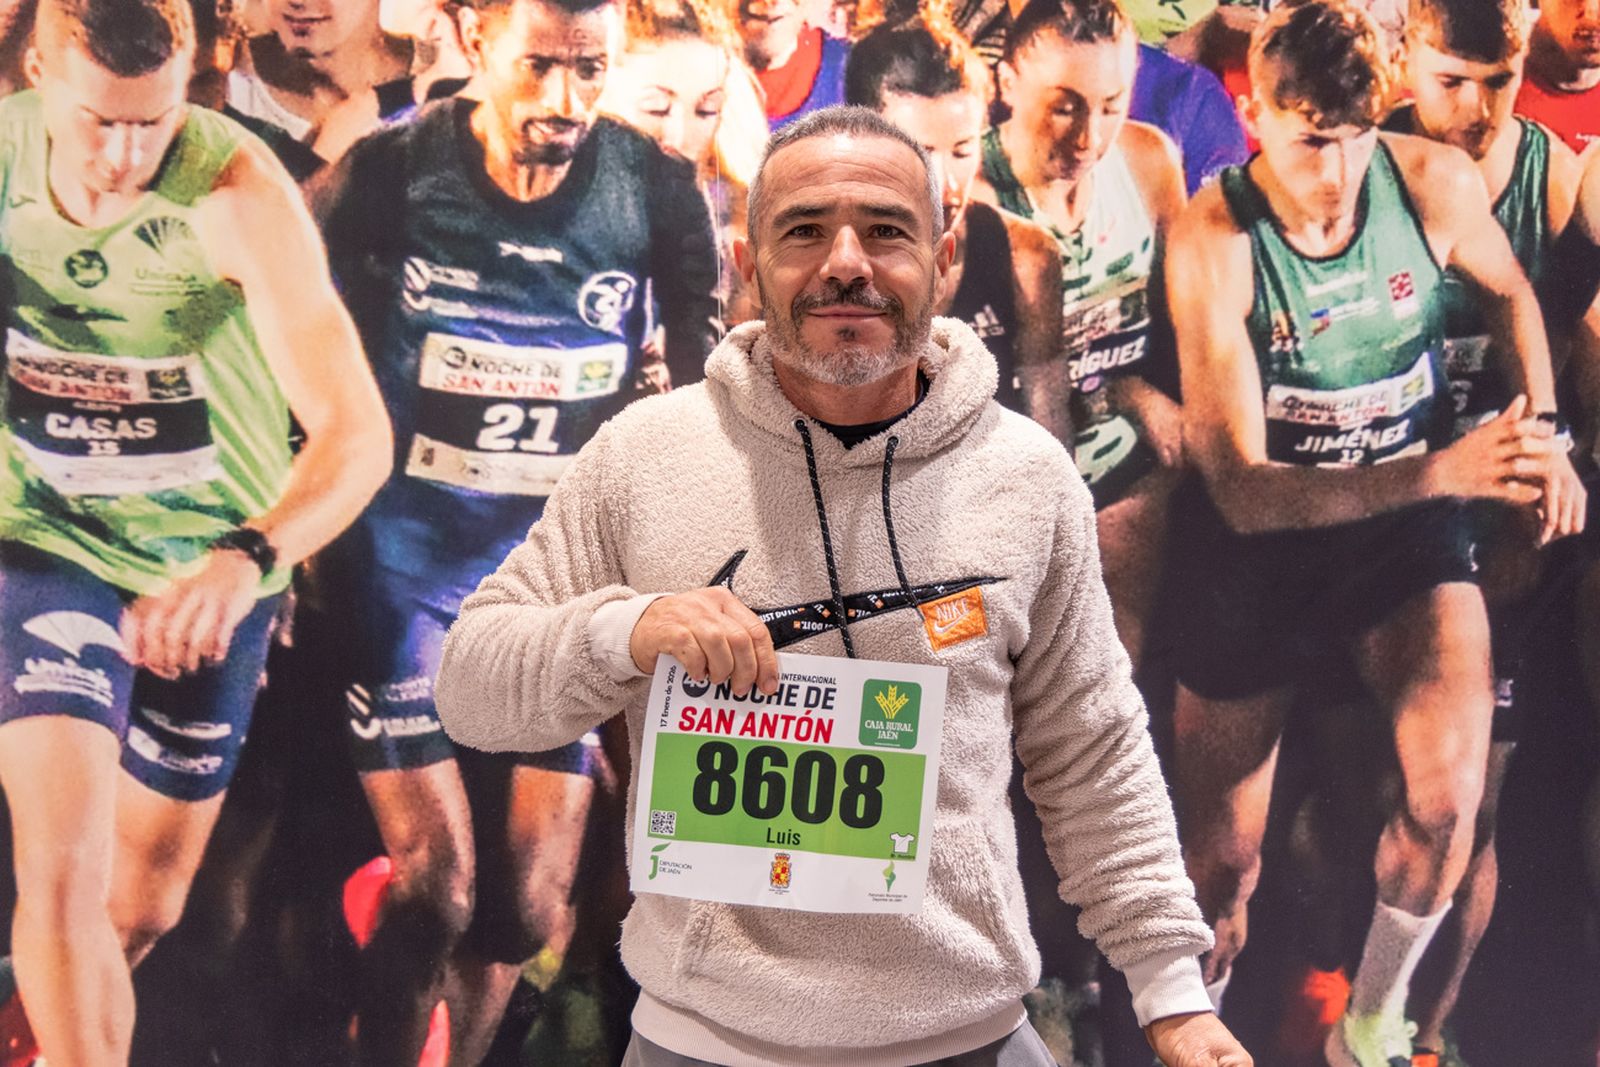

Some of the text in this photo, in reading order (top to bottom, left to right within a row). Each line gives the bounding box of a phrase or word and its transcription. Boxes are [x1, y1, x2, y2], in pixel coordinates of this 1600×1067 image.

[45, 413, 158, 440] CASAS
[475, 403, 559, 453] 21
[1294, 418, 1410, 453] JIMÉNEZ
[760, 612, 775, 623] UST
[935, 597, 971, 621] NIKE
[781, 673, 837, 685] INTERNACIONAL
[665, 685, 673, 695] de
[804, 686, 837, 710] DE
[661, 696, 671, 717] Enero
[660, 718, 668, 727] 17
[678, 706, 834, 744] SAN ANTÓN
[864, 720, 914, 732] CAJA RURAL
[877, 730, 899, 740] JAÉN
[692, 740, 885, 829] 8608
[766, 827, 801, 846] Luis
